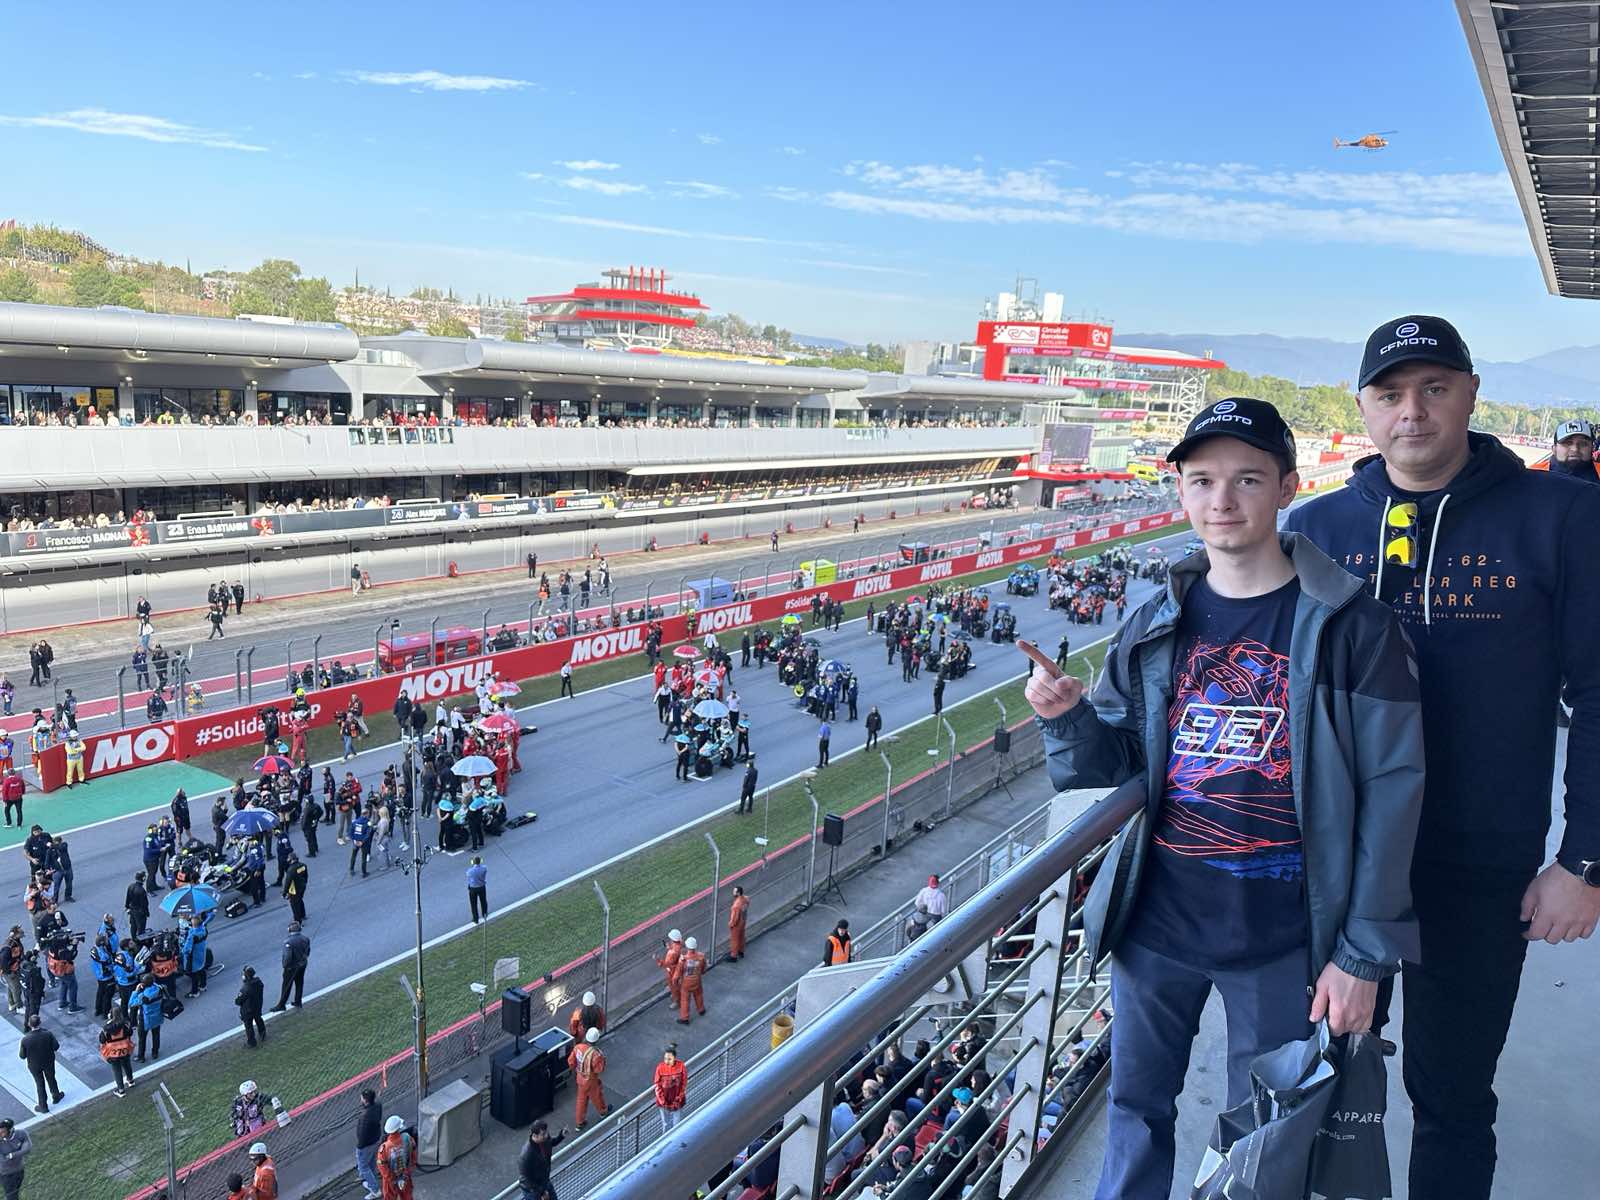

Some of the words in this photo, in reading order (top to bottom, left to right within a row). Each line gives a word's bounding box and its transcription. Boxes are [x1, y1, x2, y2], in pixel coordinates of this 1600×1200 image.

[1380, 337, 1438, 355] CFMOTO
[1194, 414, 1252, 431] CFMOTO
[168, 524, 185, 536] 23
[206, 522, 248, 534] BASTIANINI
[46, 535, 92, 546] Francesco
[94, 531, 132, 543] BAGNAIA
[976, 550, 1004, 568] MOTUL
[920, 561, 952, 582] MOTUL
[853, 574, 892, 598] MOTUL
[1472, 576, 1516, 588] REG
[697, 604, 752, 634] MOTUL
[570, 628, 643, 664] MOTUL
